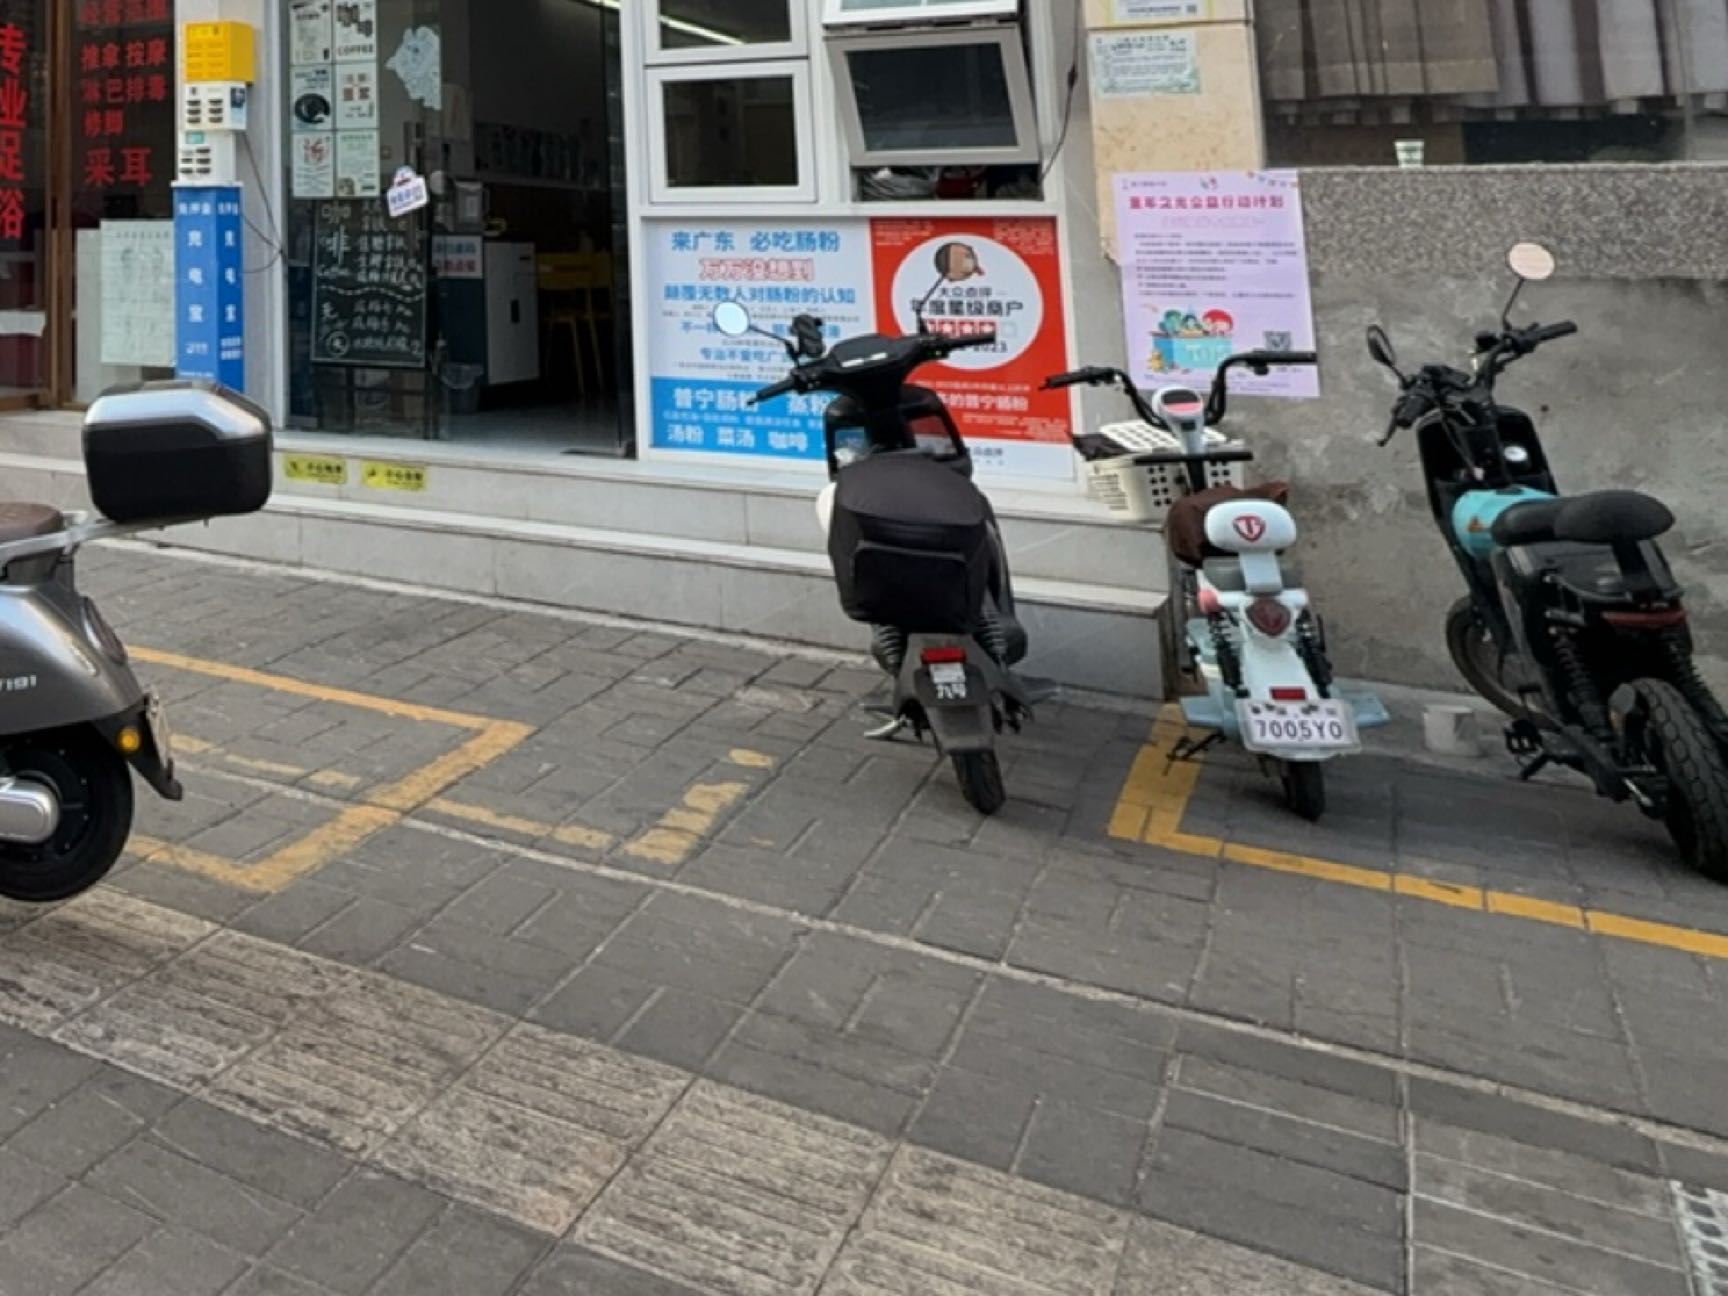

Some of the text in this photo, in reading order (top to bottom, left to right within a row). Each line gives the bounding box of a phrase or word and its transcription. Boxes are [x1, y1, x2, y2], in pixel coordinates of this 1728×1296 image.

[85, 148, 152, 186] 采耳
[671, 231, 840, 251] 来广东 必吃肠粉
[699, 258, 814, 281] 万万没想到
